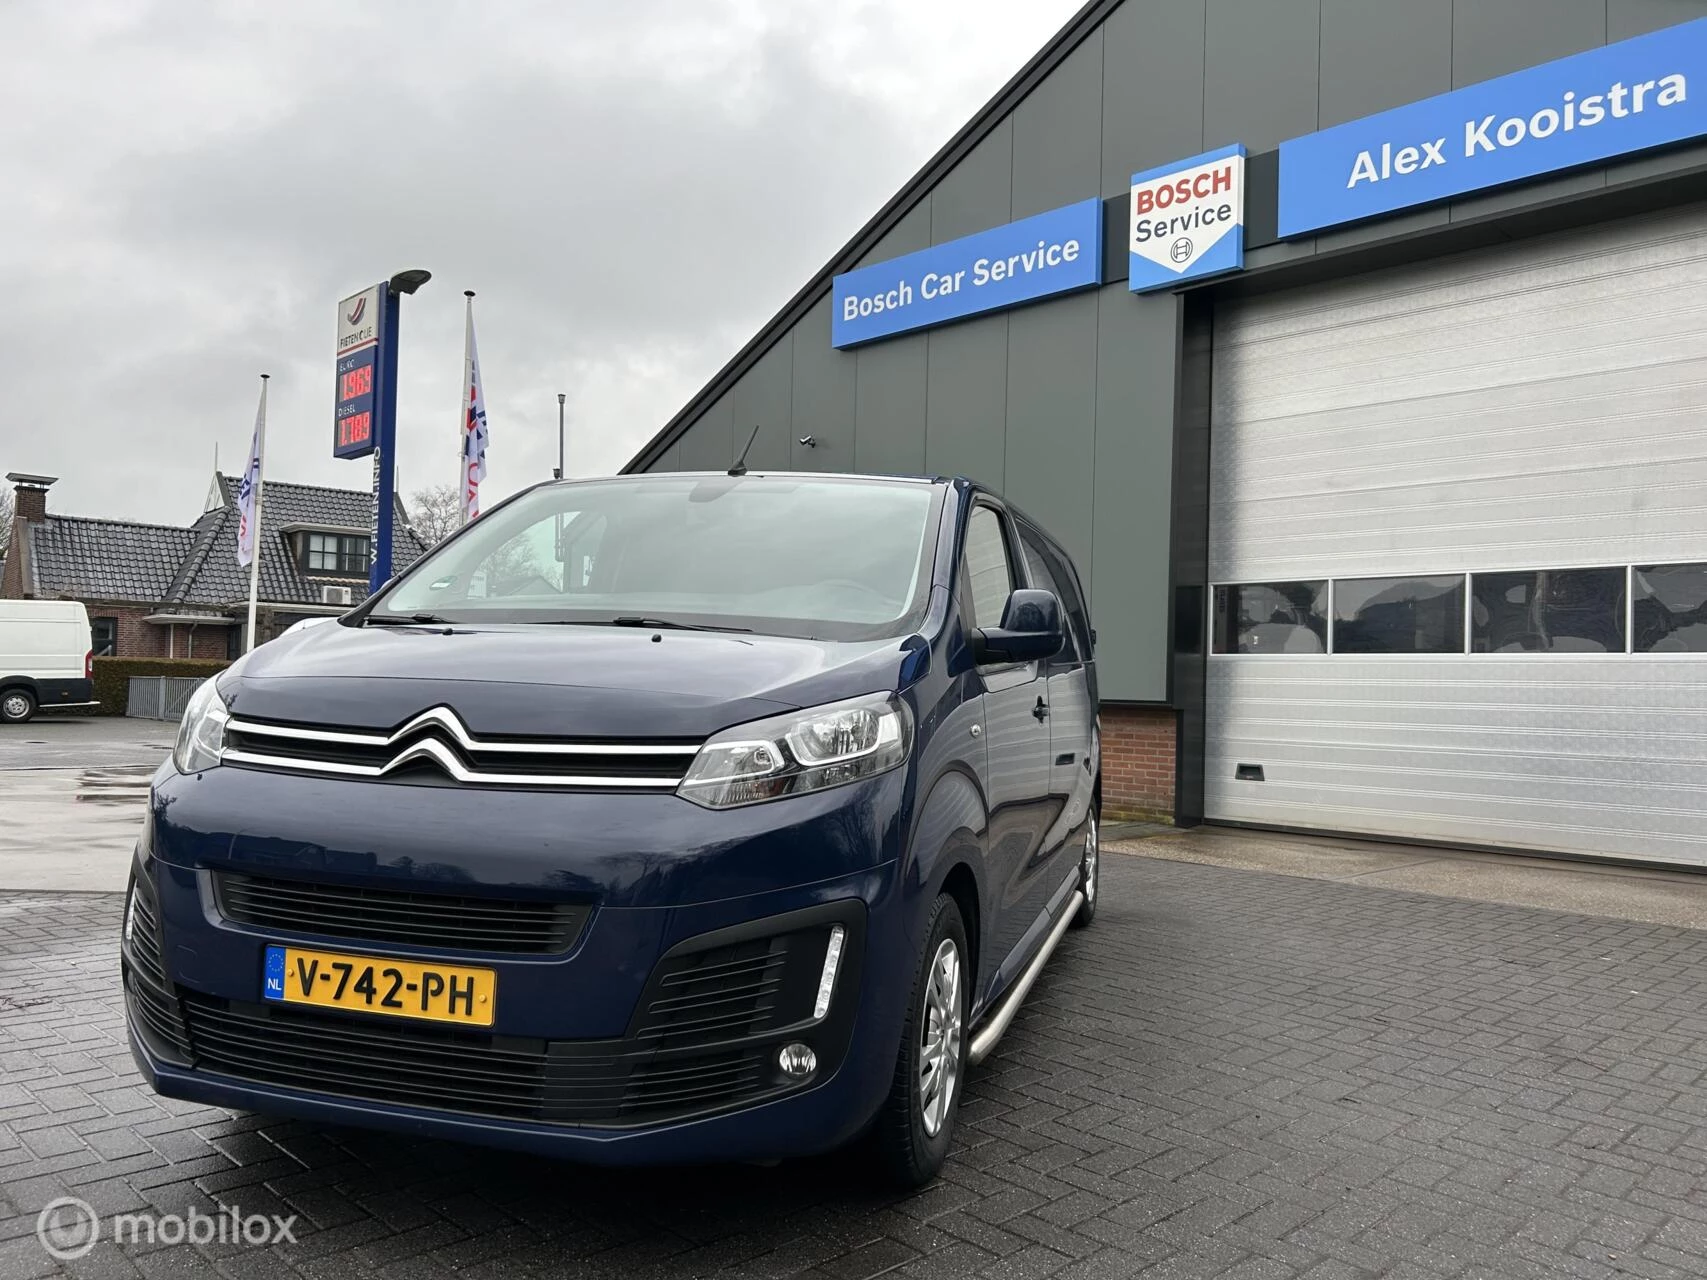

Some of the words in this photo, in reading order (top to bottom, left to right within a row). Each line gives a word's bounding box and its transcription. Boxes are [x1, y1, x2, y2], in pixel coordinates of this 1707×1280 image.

[1346, 143, 1447, 189] Alex
[1464, 73, 1687, 157] Kooistra
[1136, 166, 1232, 216] BOSCH
[1135, 203, 1232, 243] Service
[843, 280, 912, 321] Bosch
[920, 269, 966, 300] Car
[972, 239, 1080, 286] Service
[338, 404, 355, 417] DIESEL
[267, 978, 282, 991] NL
[296, 957, 475, 1016] V-742-PH
